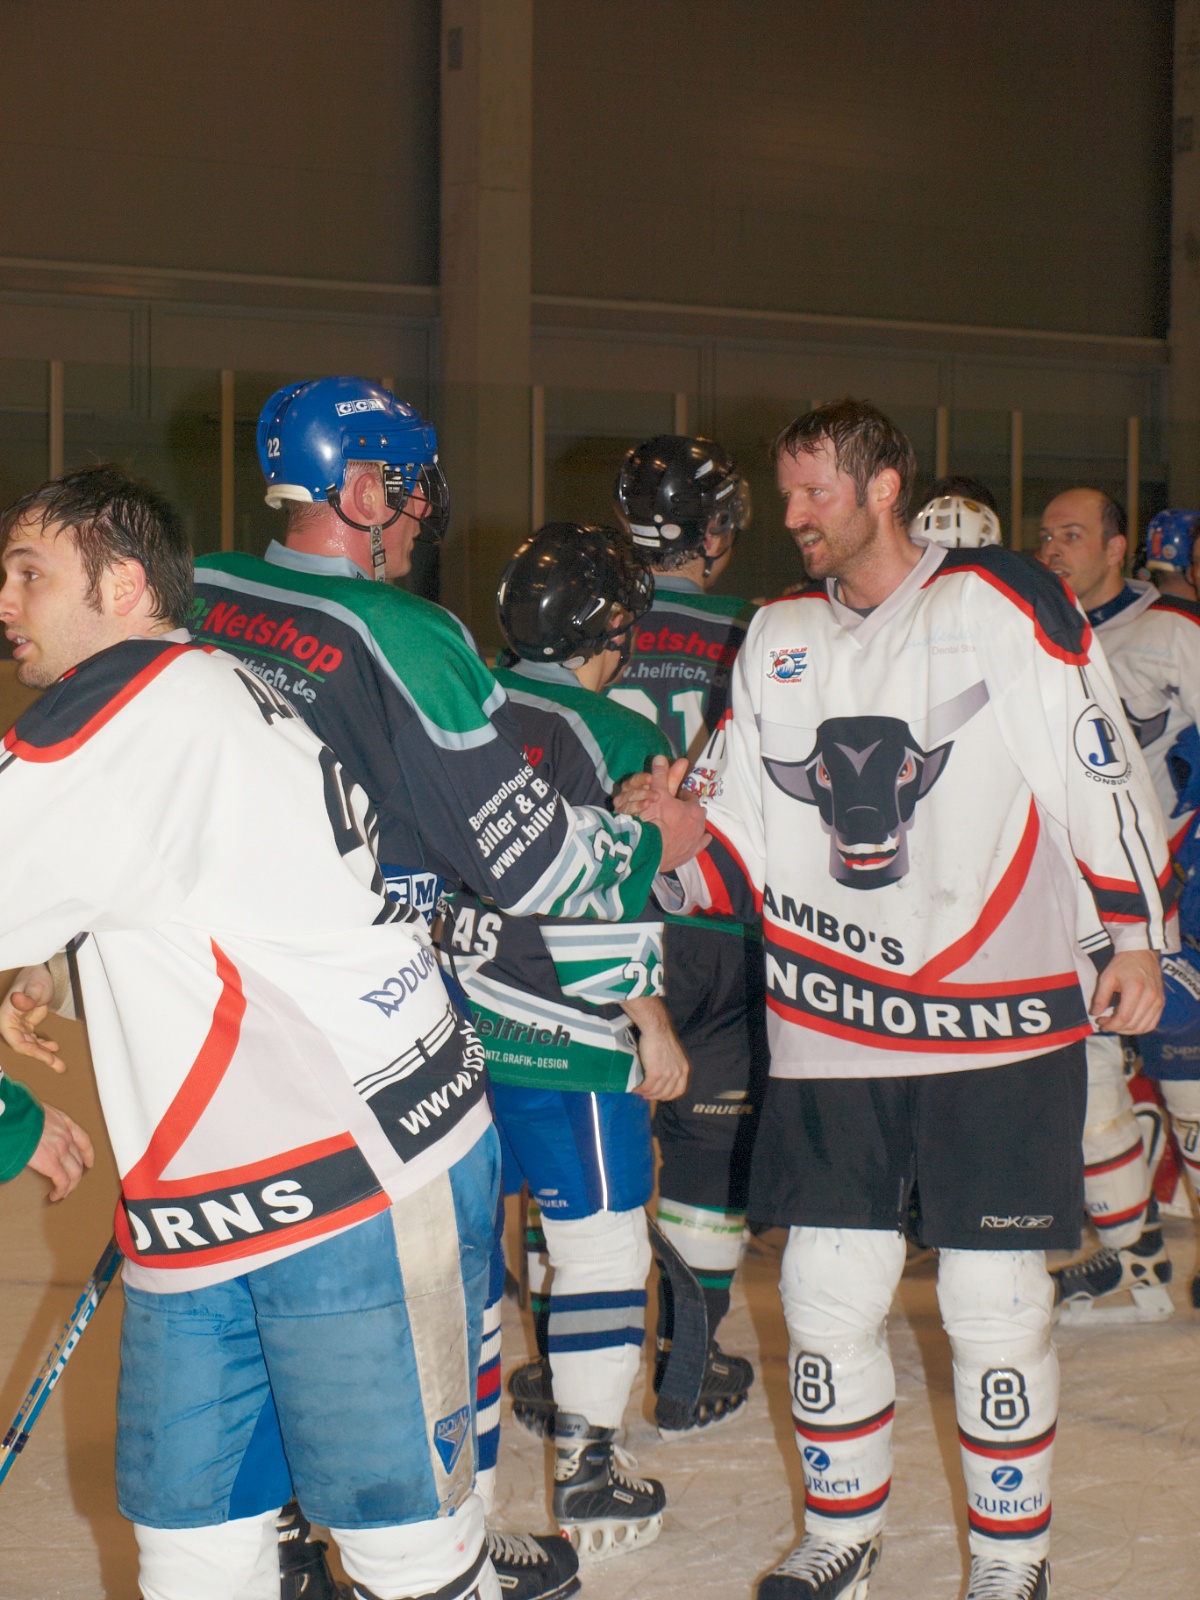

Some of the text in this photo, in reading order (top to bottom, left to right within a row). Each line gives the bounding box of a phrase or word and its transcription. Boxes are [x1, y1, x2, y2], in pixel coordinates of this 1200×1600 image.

[336, 399, 385, 416] CCM
[267, 438, 280, 458] 22
[202, 601, 343, 673] Netshop
[468, 764, 534, 831] Baugeologis
[514, 793, 536, 814] &
[592, 828, 633, 874] 3
[794, 1351, 836, 1414] 8
[981, 1367, 1030, 1431] 8
[974, 1493, 1043, 1514] ZURICH
